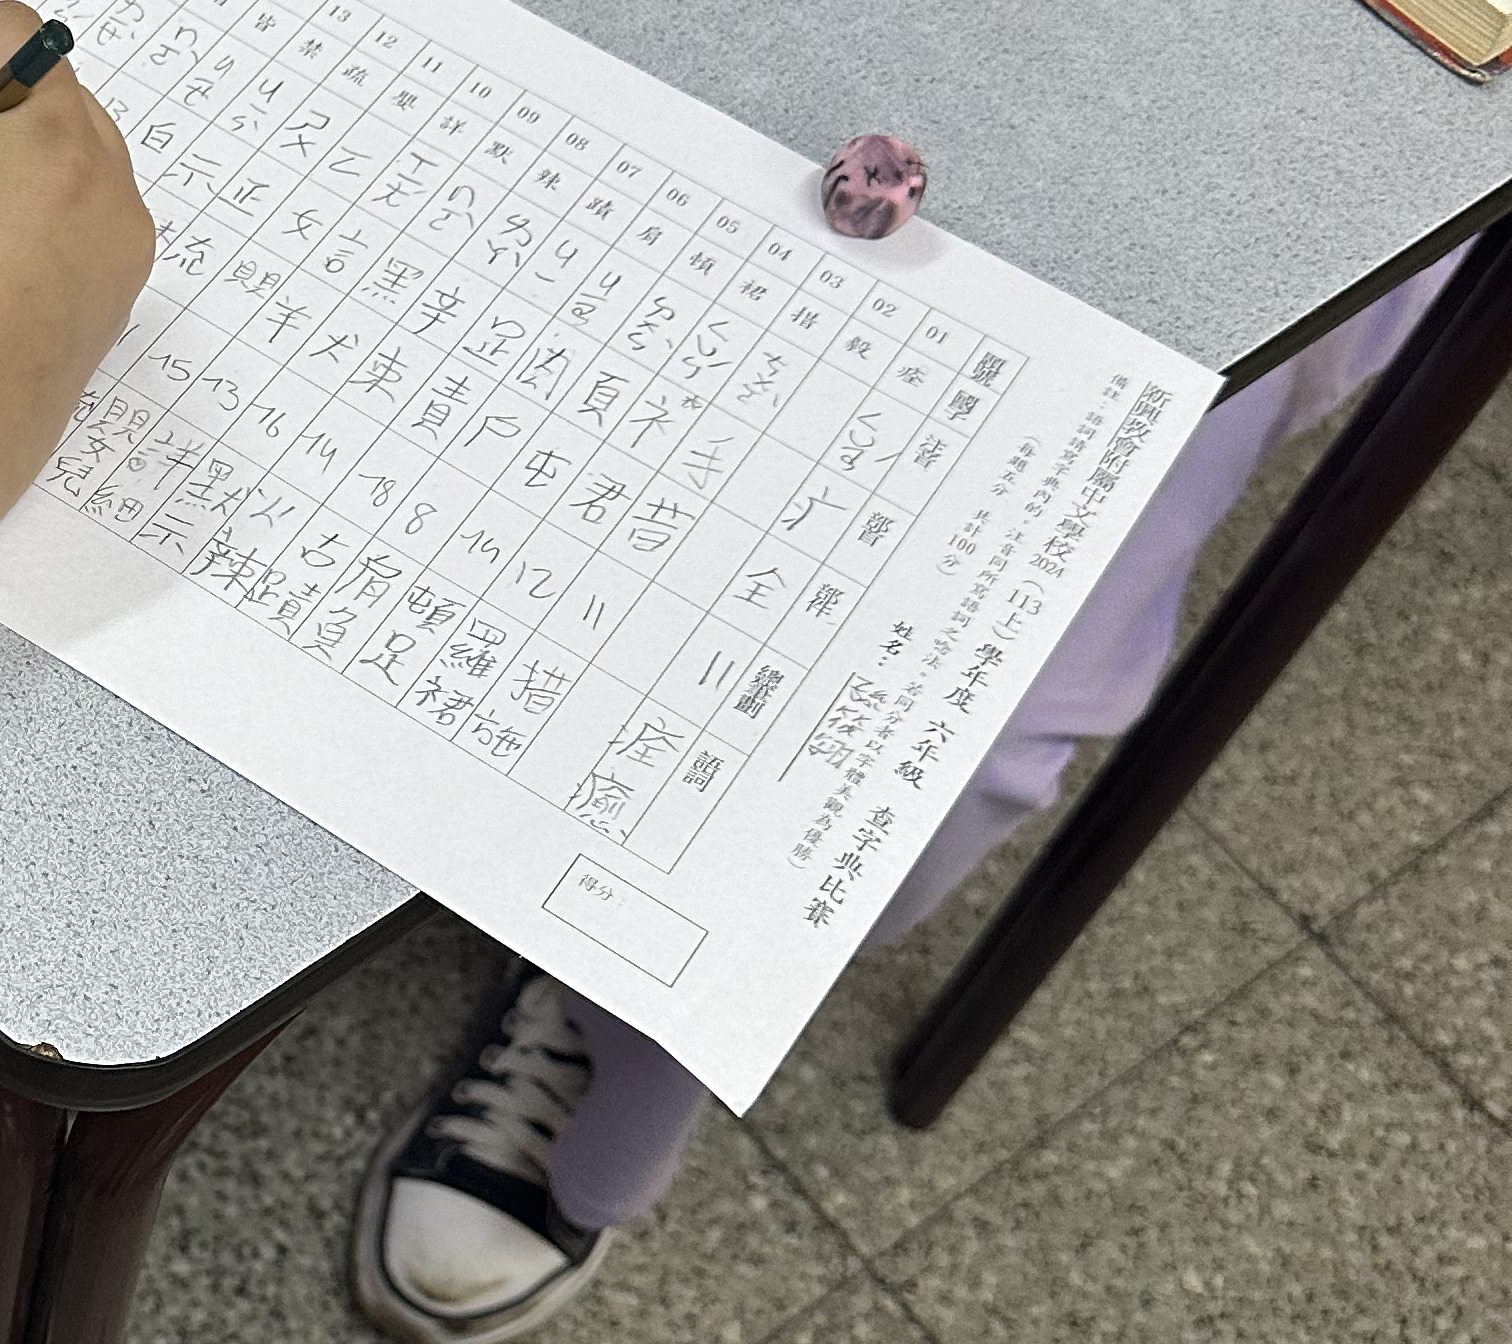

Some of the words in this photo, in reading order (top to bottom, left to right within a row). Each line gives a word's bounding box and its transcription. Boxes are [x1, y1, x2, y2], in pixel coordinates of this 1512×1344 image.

[253, 11, 277, 33] 皆
[327, 4, 353, 24] 13
[298, 37, 324, 60] 禁
[374, 30, 399, 50] 12
[340, 65, 370, 87] 疏
[421, 56, 444, 74] 11
[391, 89, 420, 112] 嬰
[468, 81, 493, 100] 10
[438, 115, 468, 137] 詳
[516, 105, 541, 125] 09
[139, 121, 178, 156] 白
[564, 131, 590, 152] 08
[483, 140, 511, 166] 默
[163, 152, 223, 193] 示
[534, 167, 561, 193] 辣
[615, 159, 643, 180] 07
[583, 196, 614, 222] 蹟
[665, 187, 688, 208] 06
[280, 207, 324, 242] 女
[636, 225, 664, 247] 肩
[715, 214, 741, 235] 05
[323, 228, 370, 275] 言
[688, 250, 717, 277] 頓
[766, 241, 794, 263] 04
[360, 255, 426, 306] 黑
[739, 282, 769, 303] 裙
[818, 269, 845, 290] 03
[265, 294, 313, 345] 羊
[414, 285, 467, 335] 辛
[789, 305, 820, 331] 措
[870, 296, 898, 319] 02
[845, 335, 872, 361] 毅
[924, 325, 949, 346] 01
[146, 352, 194, 383] 15
[896, 365, 926, 389] 痊
[200, 376, 241, 413] 13
[576, 369, 631, 428] 頁
[252, 402, 288, 439] 16
[409, 374, 472, 442] 責
[680, 435, 736, 492] 手
[912, 433, 948, 470] 注音
[357, 472, 398, 509] 18
[568, 471, 633, 526] 君
[403, 501, 439, 536] 8
[626, 496, 697, 553] 昔
[856, 510, 896, 549] 部首
[731, 566, 787, 610] 全
[804, 582, 846, 619] 部件
[681, 749, 726, 794] 語詞
[802, 805, 896, 930] 查字典比賽
